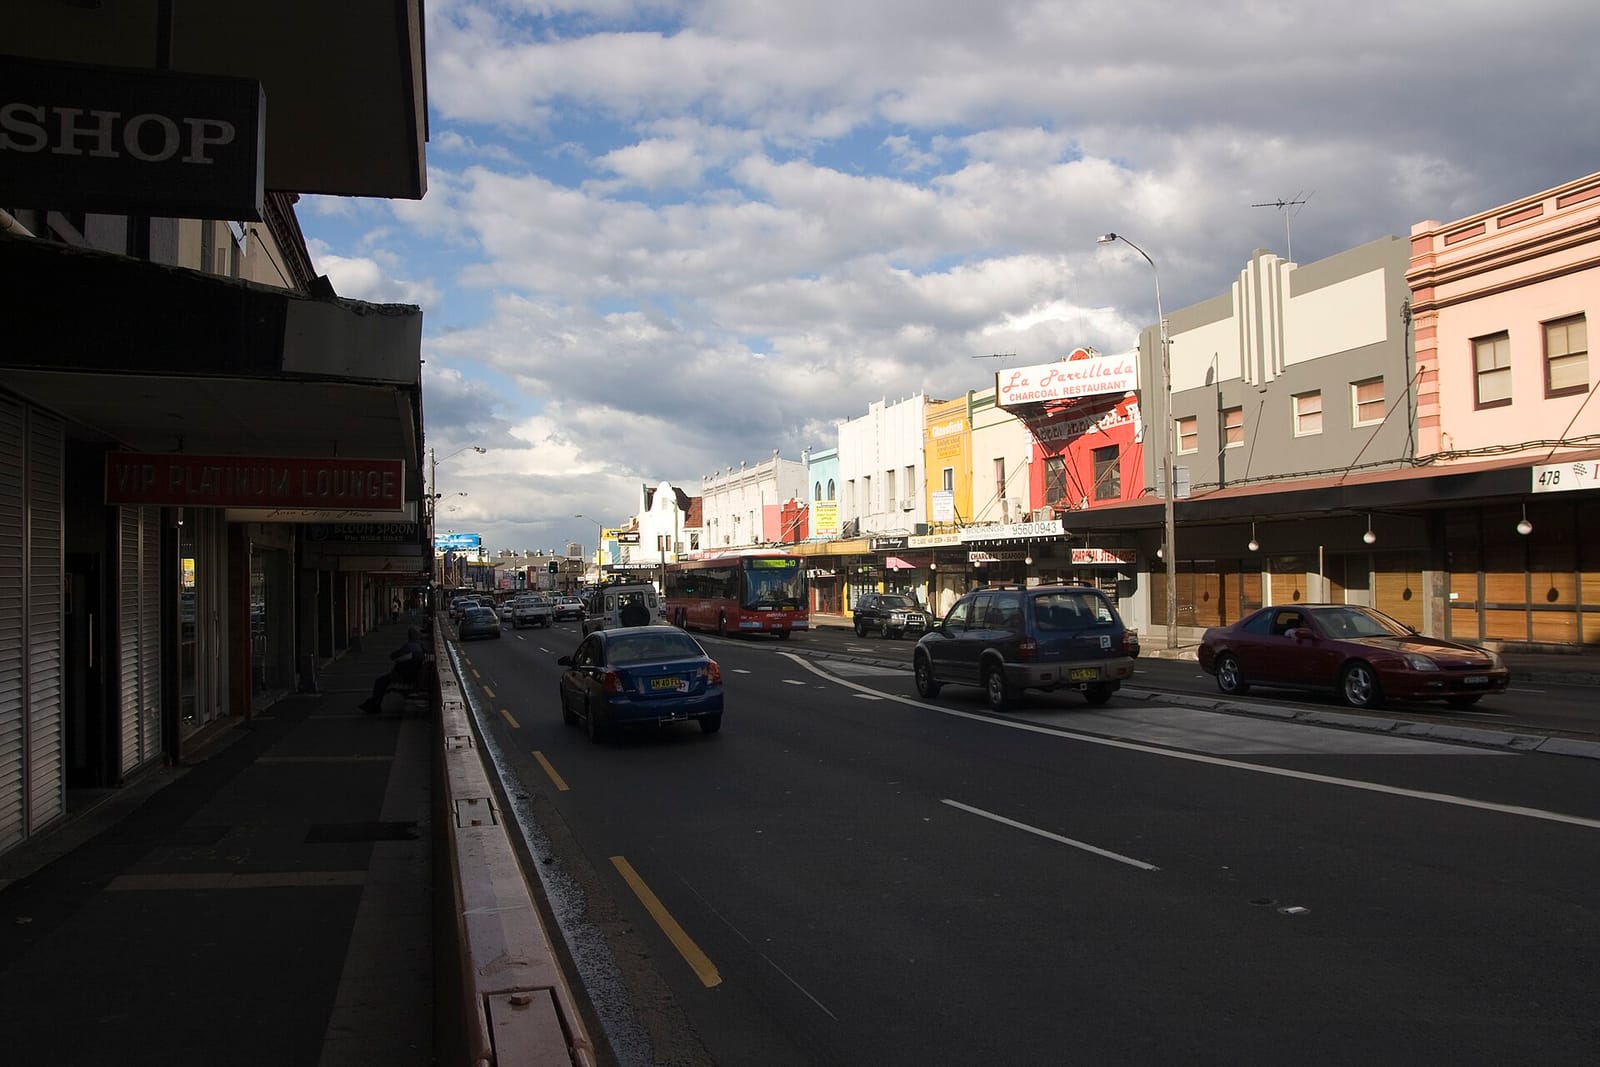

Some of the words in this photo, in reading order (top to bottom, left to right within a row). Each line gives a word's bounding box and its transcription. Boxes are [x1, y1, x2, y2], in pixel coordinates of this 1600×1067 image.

[0, 103, 236, 164] SHOP
[1002, 371, 1029, 393] La
[1040, 361, 1133, 387] Parrillada
[1009, 388, 1059, 402] CHARCOAL
[1063, 380, 1127, 396] RESTAURANT
[114, 463, 156, 496] VIP
[168, 464, 289, 498] PLATINUM
[301, 468, 396, 498] LOUNGE
[1538, 470, 1560, 486] 478
